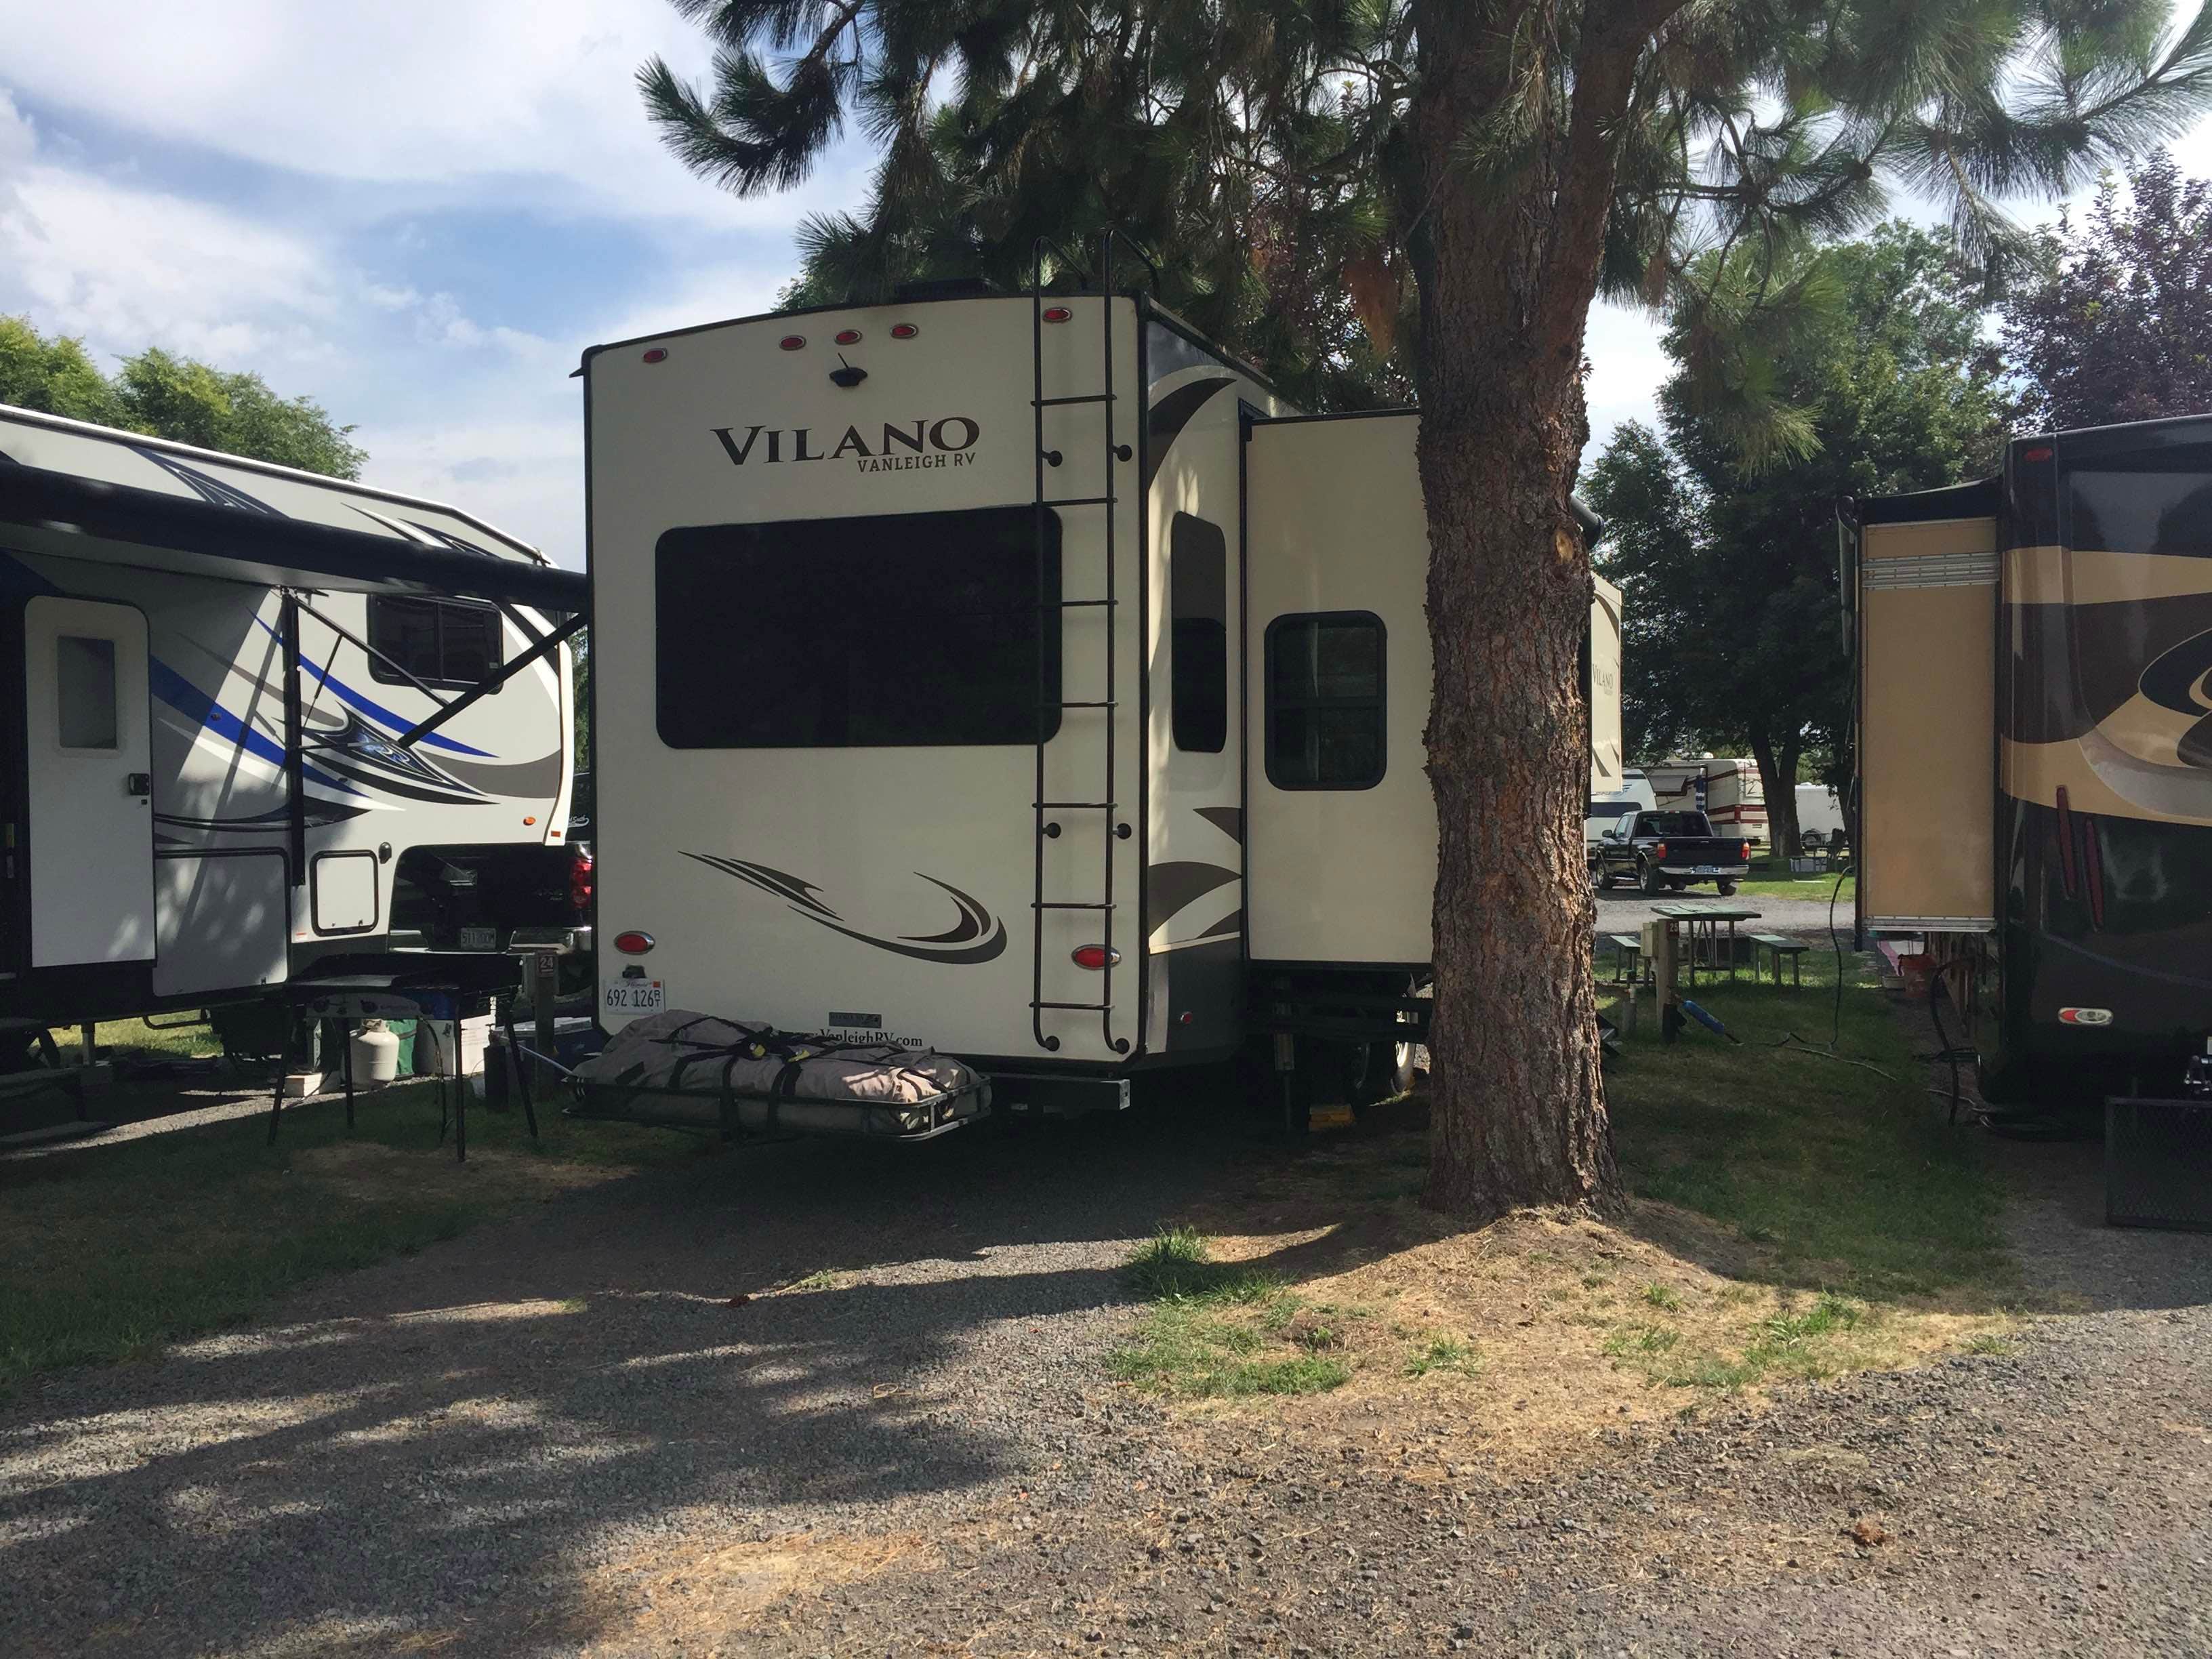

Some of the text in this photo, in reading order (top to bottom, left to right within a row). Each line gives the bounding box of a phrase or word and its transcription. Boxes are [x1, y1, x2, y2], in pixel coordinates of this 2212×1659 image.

[710, 417, 980, 466] VILANO
[857, 452, 976, 472] VANLEIGH RV
[1670, 922, 1679, 933] 25
[540, 957, 554, 968] 24
[607, 989, 628, 1007] 692
[632, 989, 654, 1007] 126
